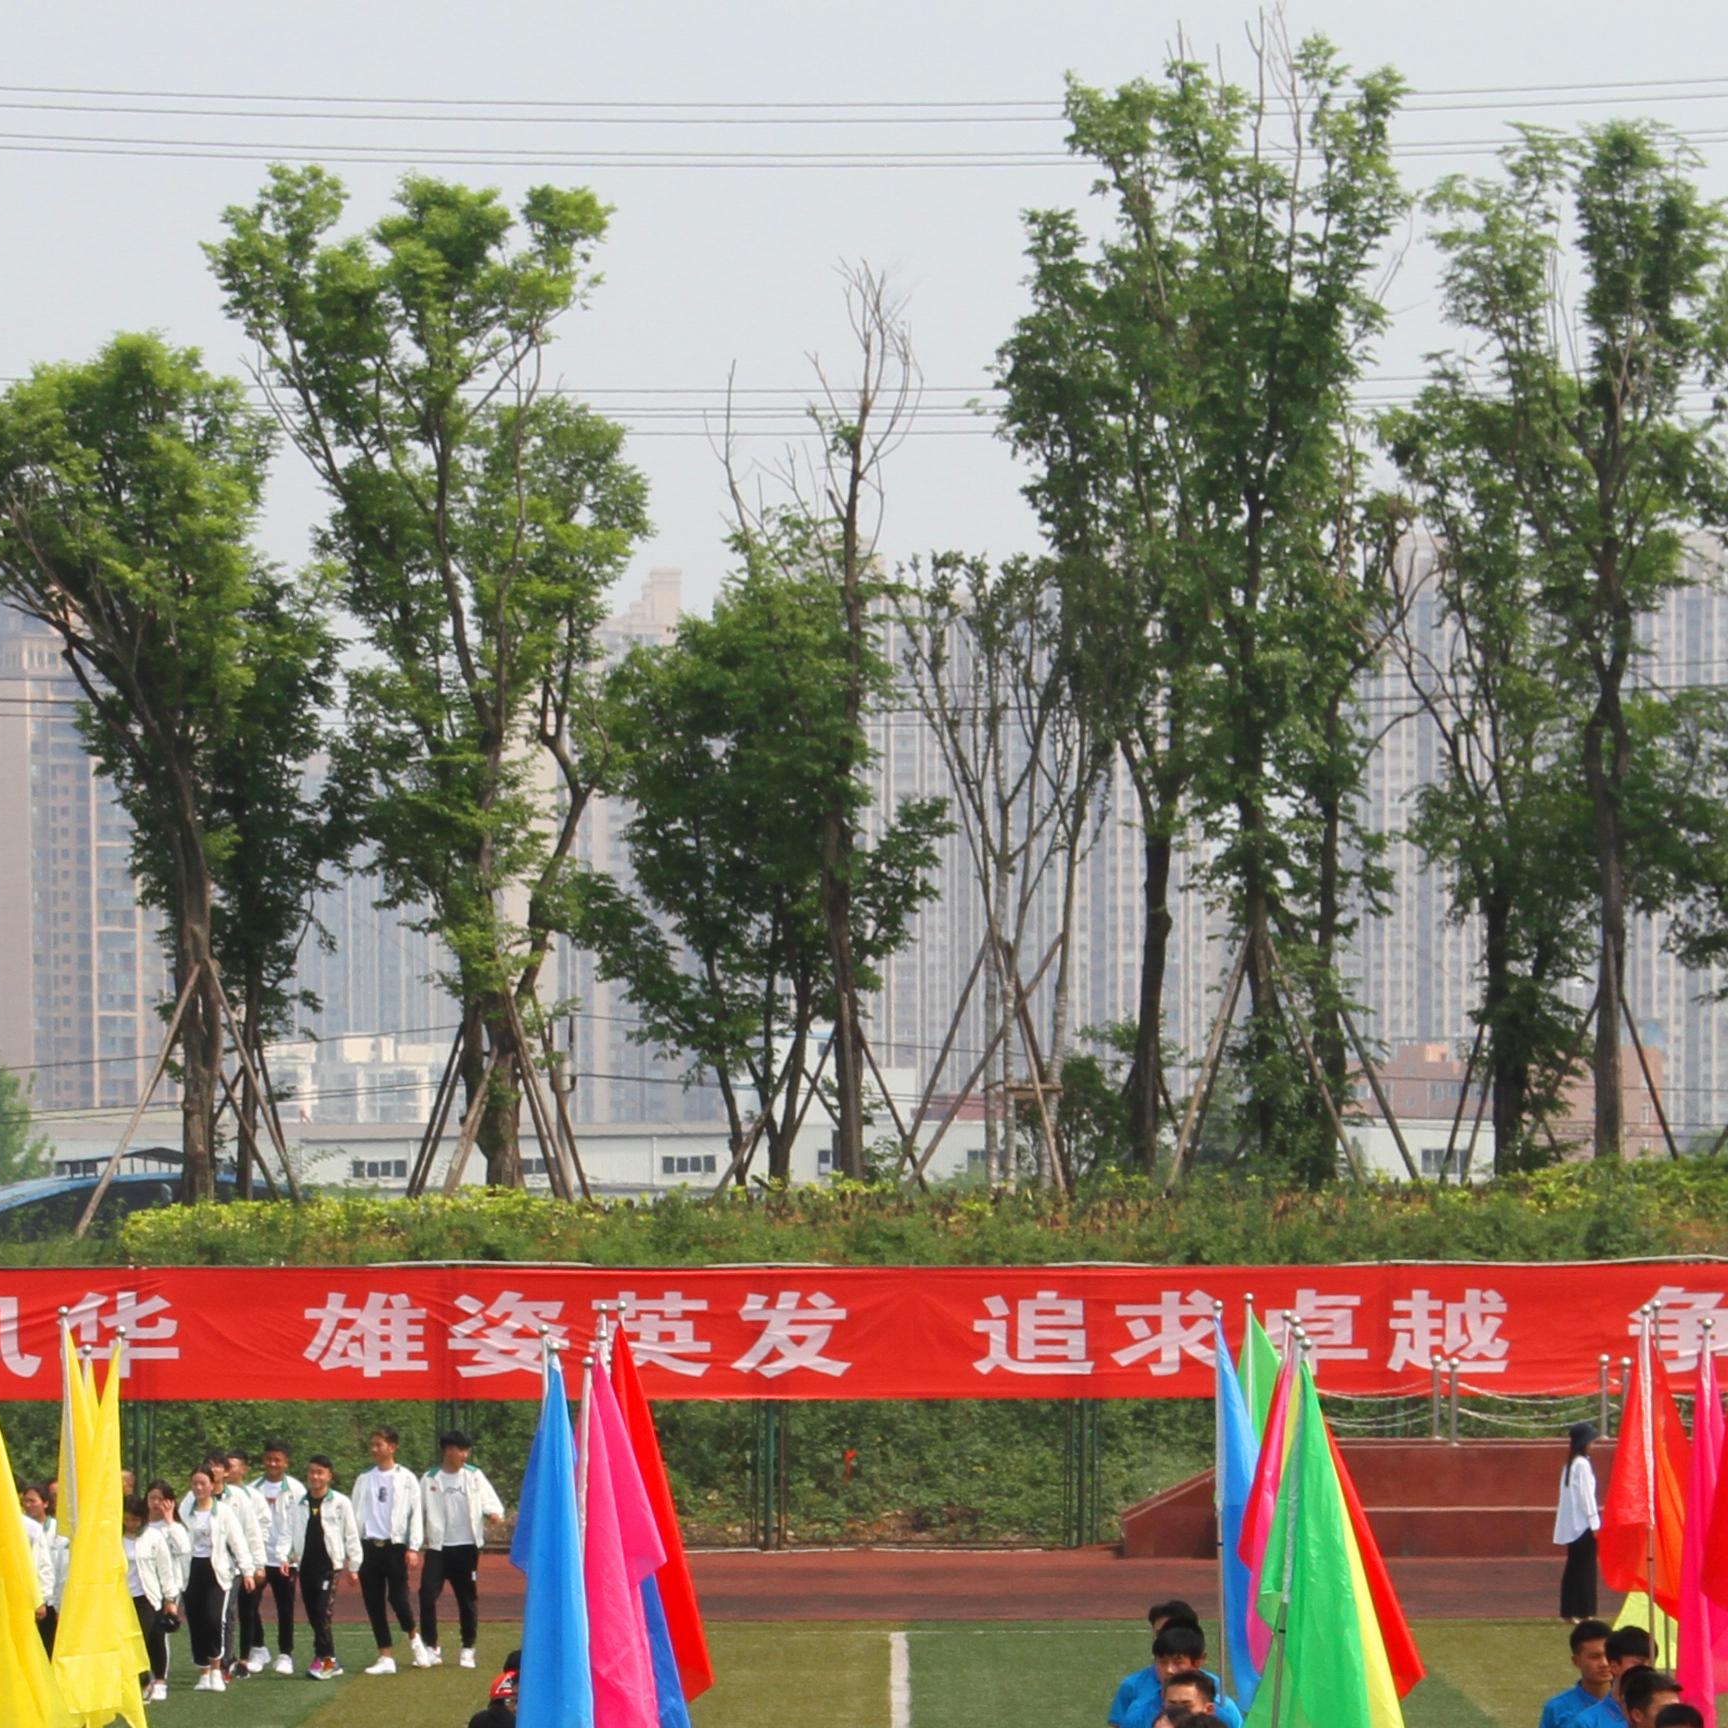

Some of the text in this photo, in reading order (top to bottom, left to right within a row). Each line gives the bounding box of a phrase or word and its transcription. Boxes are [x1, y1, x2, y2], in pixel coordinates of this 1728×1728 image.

[303, 1291, 853, 1378] 雄姿英发
[972, 1288, 1509, 1377] 追求卓越
